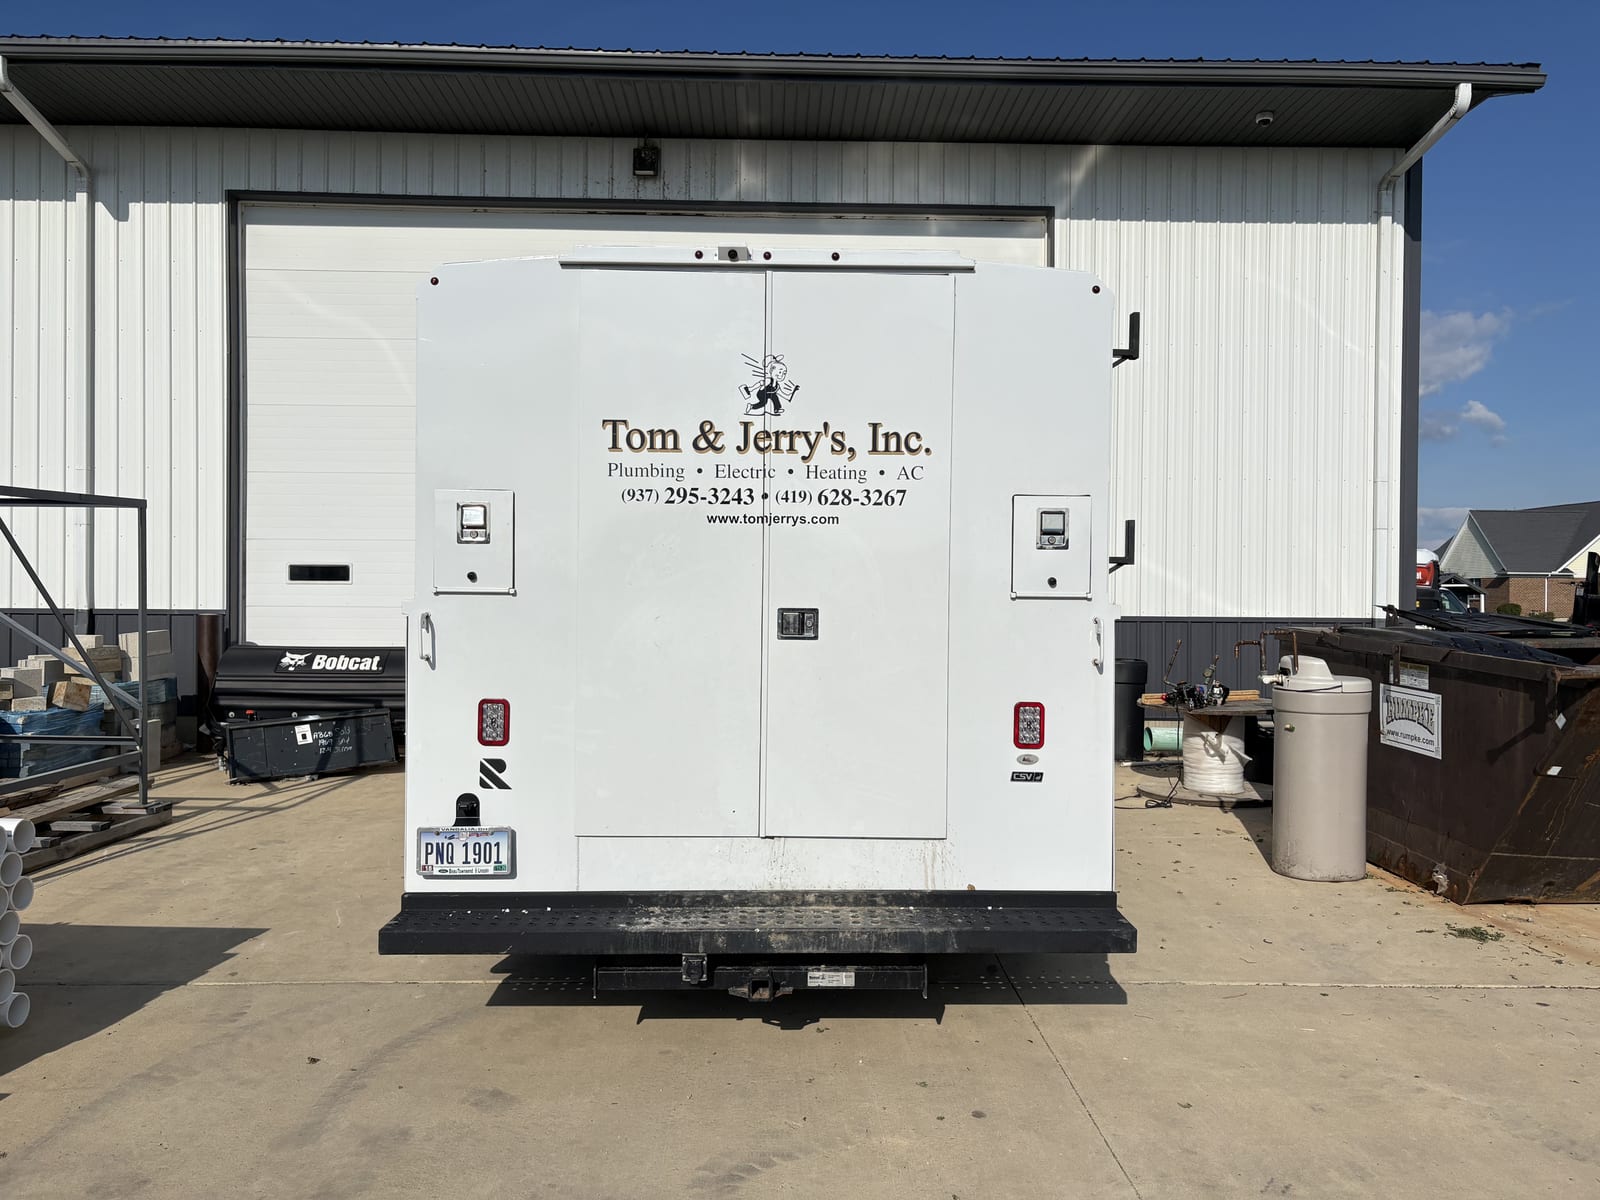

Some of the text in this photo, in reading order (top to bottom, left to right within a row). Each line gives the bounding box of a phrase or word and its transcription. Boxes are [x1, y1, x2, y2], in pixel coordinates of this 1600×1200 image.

[602, 419, 932, 463] Tom & Jerry's, Inc.
[607, 463, 924, 483] Plumbing Electric Heating AC
[621, 487, 907, 507] (937) 295-3243 (419) 628-3267
[706, 513, 839, 526] www.tomjerrys.com
[312, 654, 382, 671] Bobcat
[1386, 695, 1434, 735] RUMPKE
[1386, 729, 1434, 746] www.rumpke.com
[424, 841, 503, 865] PNQ 1901
